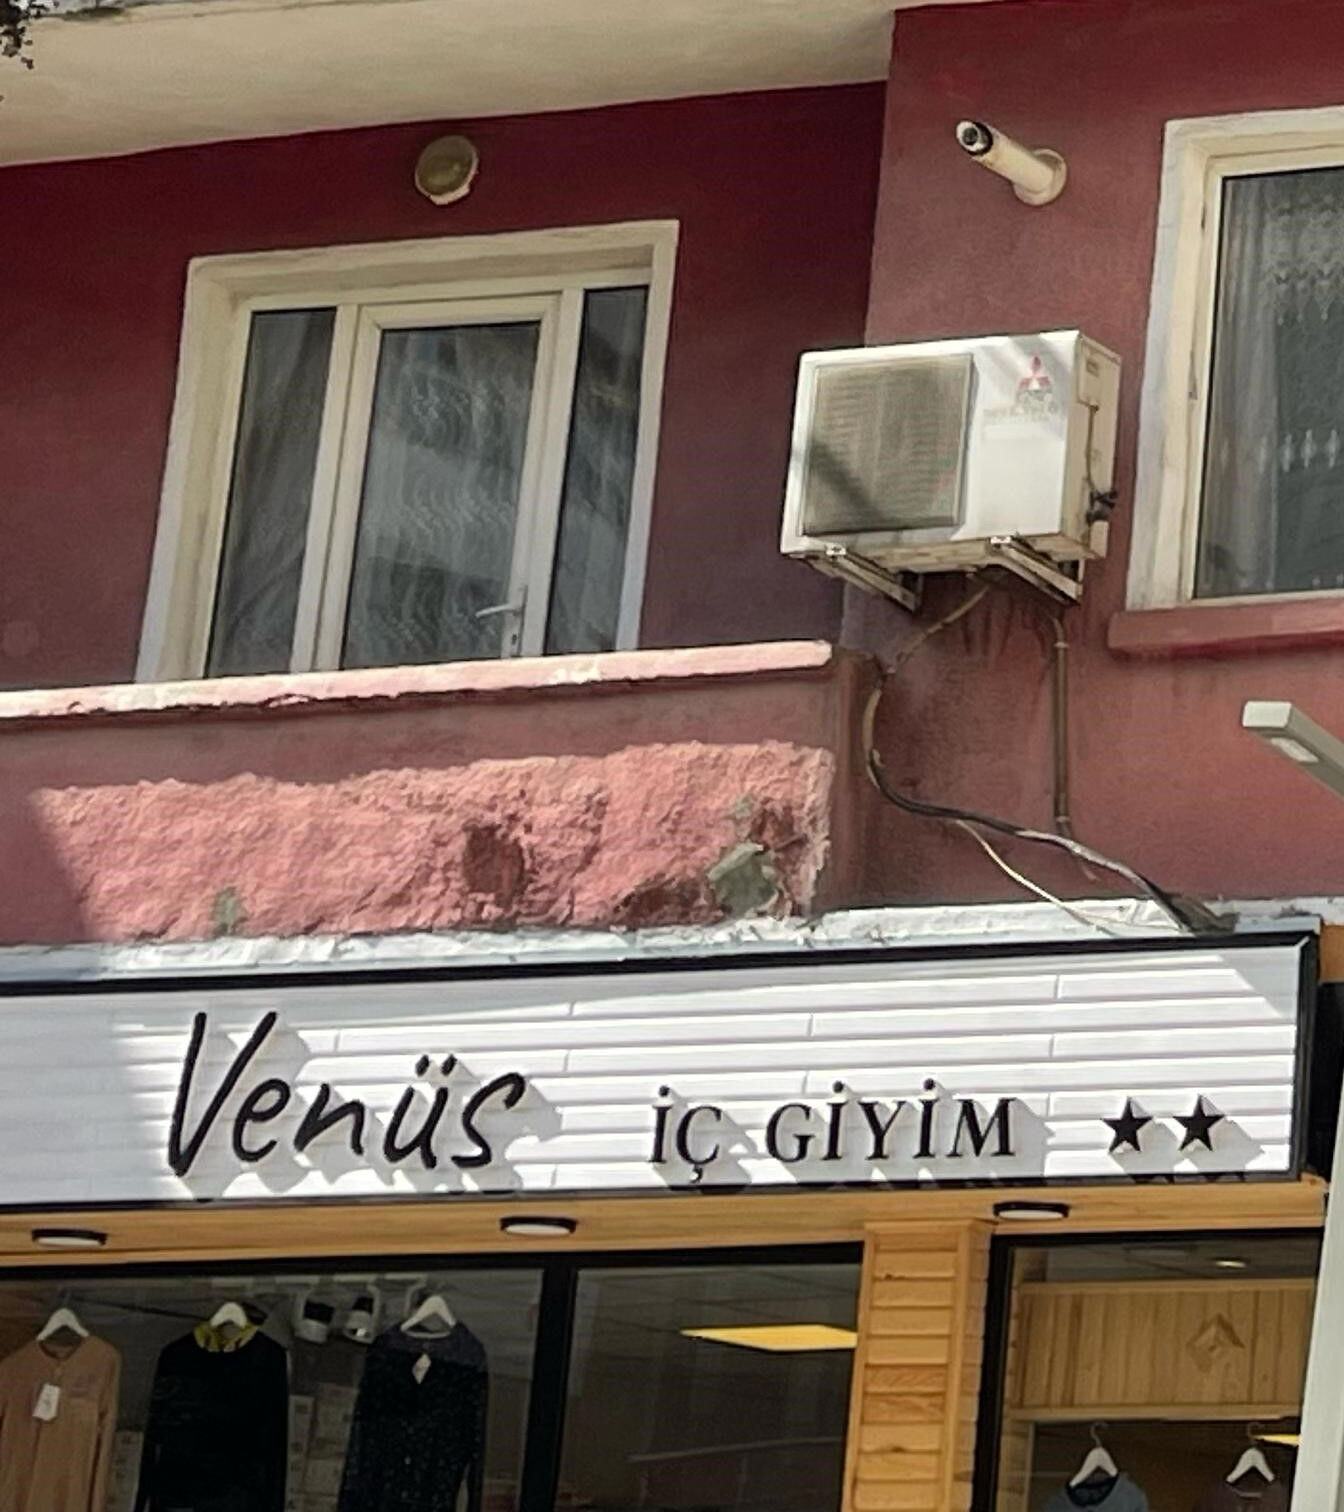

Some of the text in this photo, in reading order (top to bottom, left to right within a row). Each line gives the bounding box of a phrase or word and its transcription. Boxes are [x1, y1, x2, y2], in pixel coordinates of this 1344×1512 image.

[166, 1011, 526, 1178] Venüs
[647, 1076, 1018, 1184] İÇ GİYİM
